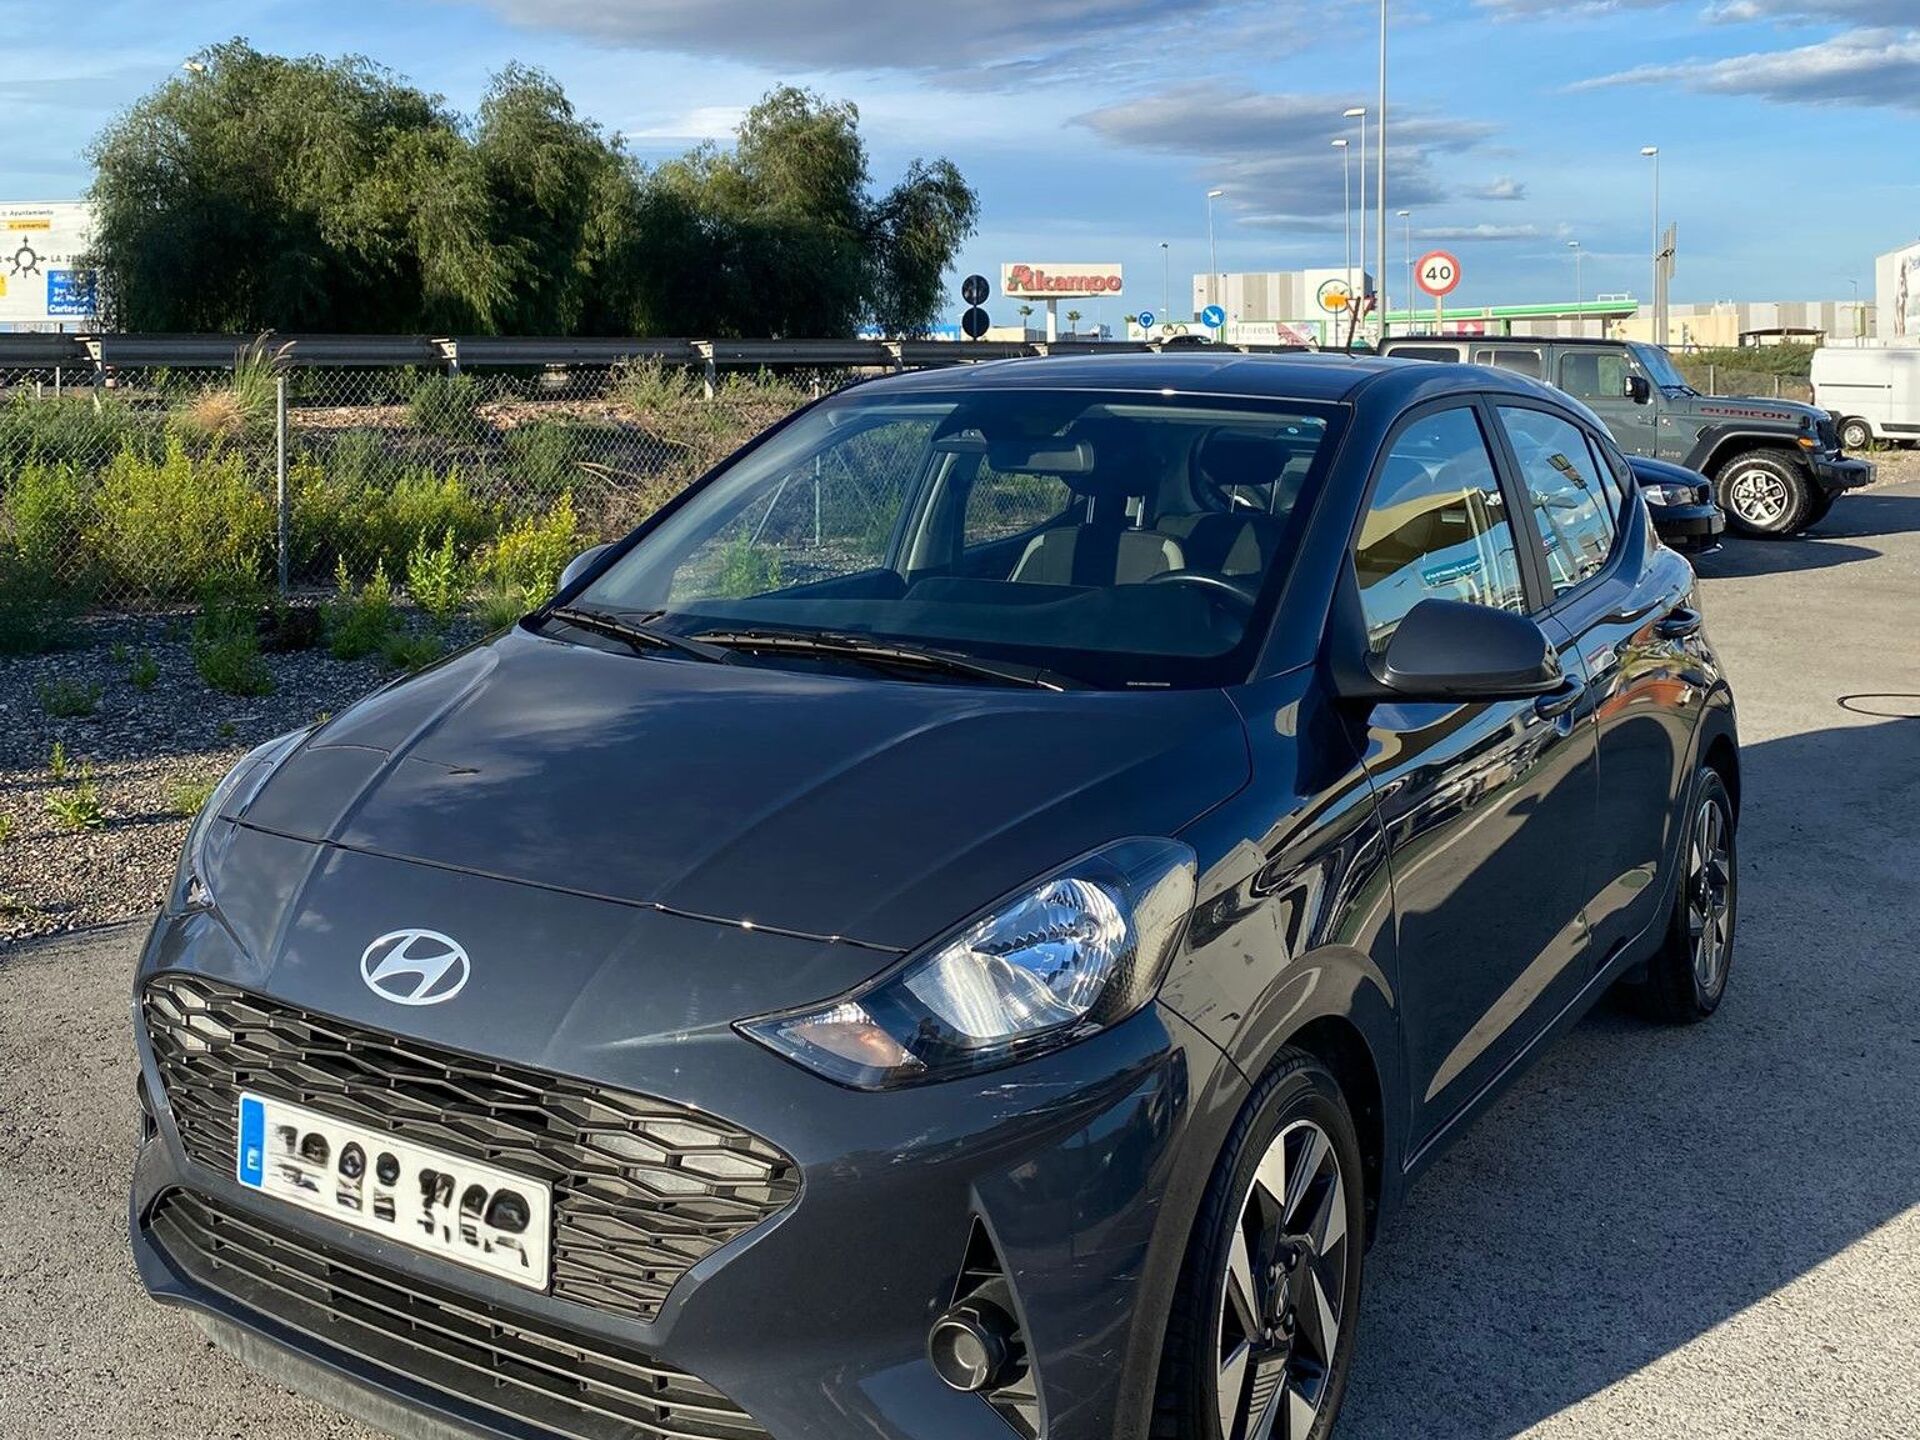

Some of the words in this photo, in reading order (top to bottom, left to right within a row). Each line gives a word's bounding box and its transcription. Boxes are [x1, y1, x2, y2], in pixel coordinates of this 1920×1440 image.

[1007, 265, 1122, 292] Alcampo
[1425, 266, 1451, 281] 40
[1700, 406, 1792, 420] RUBICON
[1660, 448, 1682, 459] Jeep
